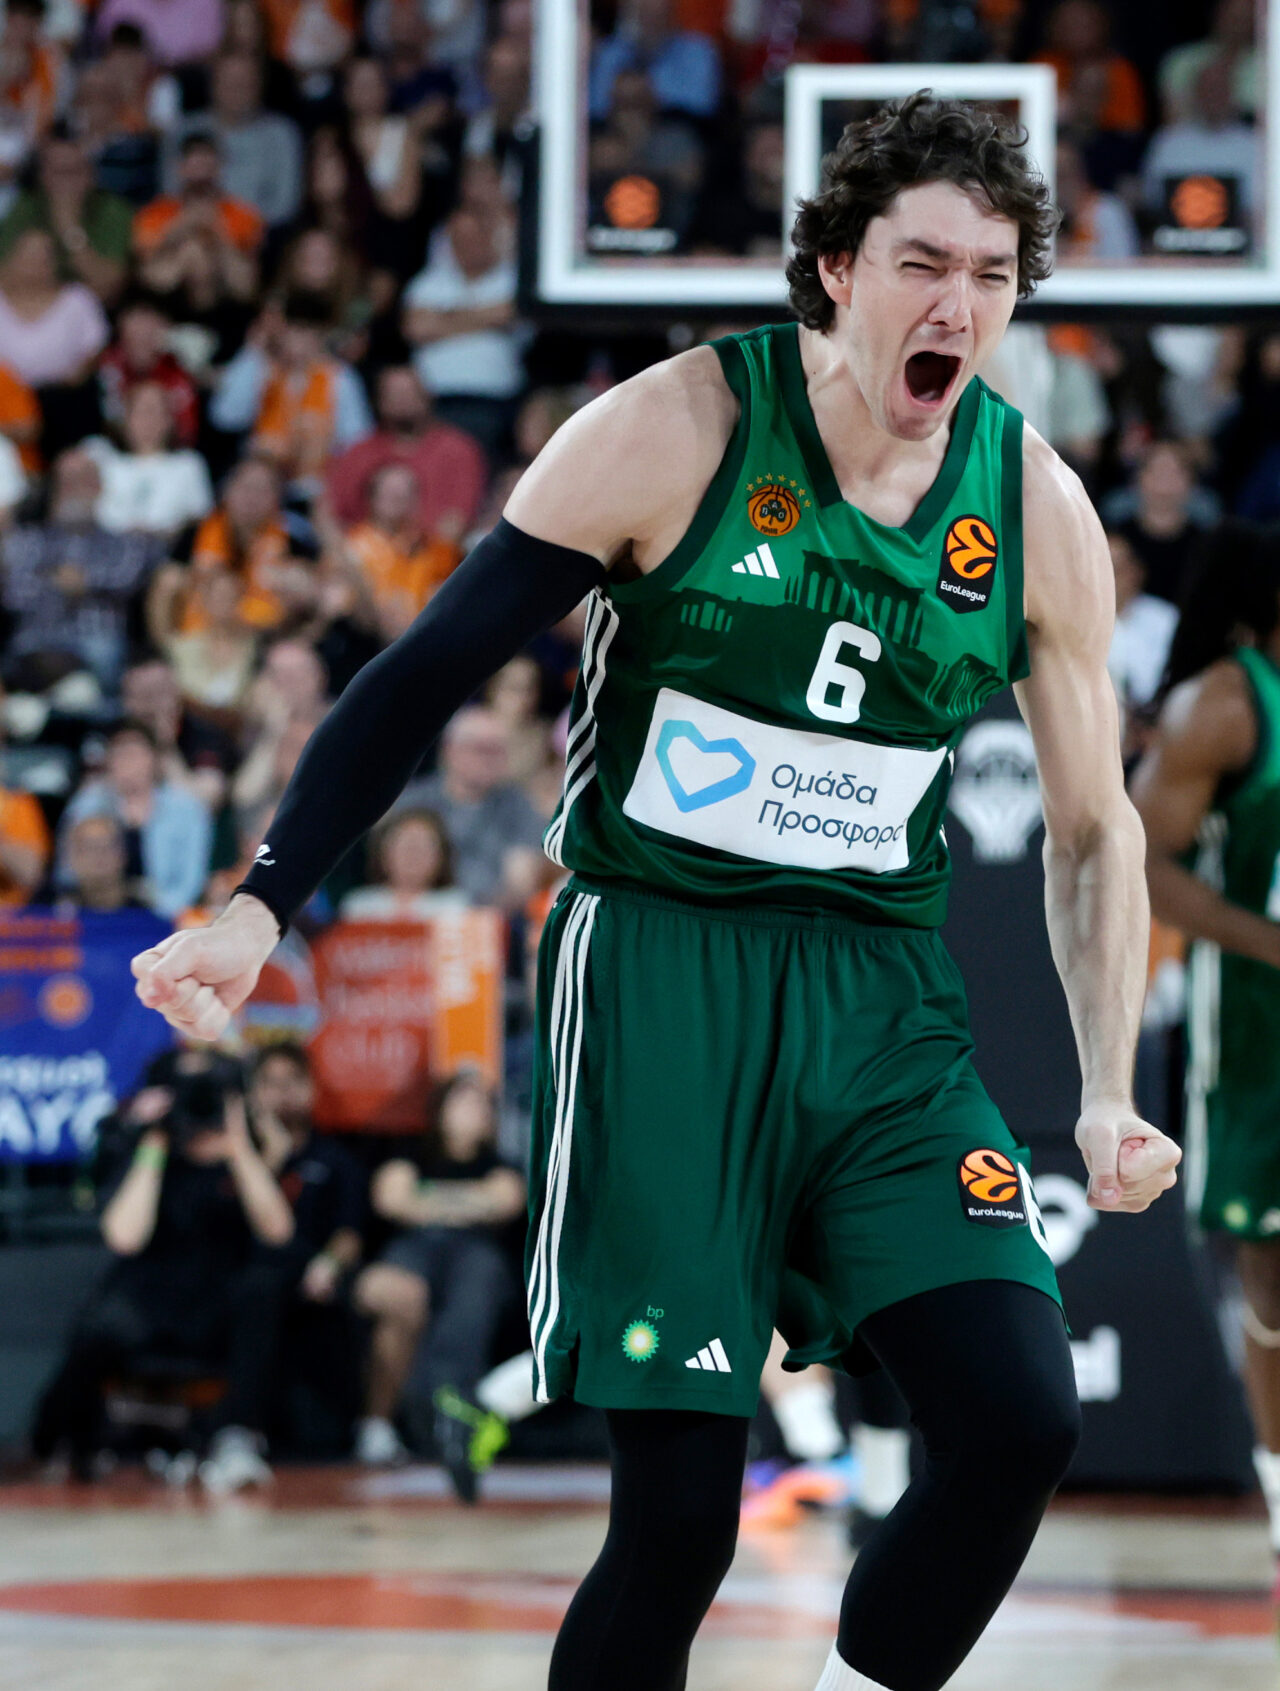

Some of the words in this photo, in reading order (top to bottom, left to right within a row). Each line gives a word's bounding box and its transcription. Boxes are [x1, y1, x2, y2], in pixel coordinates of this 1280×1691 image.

[940, 581, 986, 602] EuroLeague
[806, 621, 882, 724] 6
[771, 764, 877, 805] Ομάδα
[968, 1207, 1024, 1220] EuroLeague
[647, 1304, 665, 1321] bp
